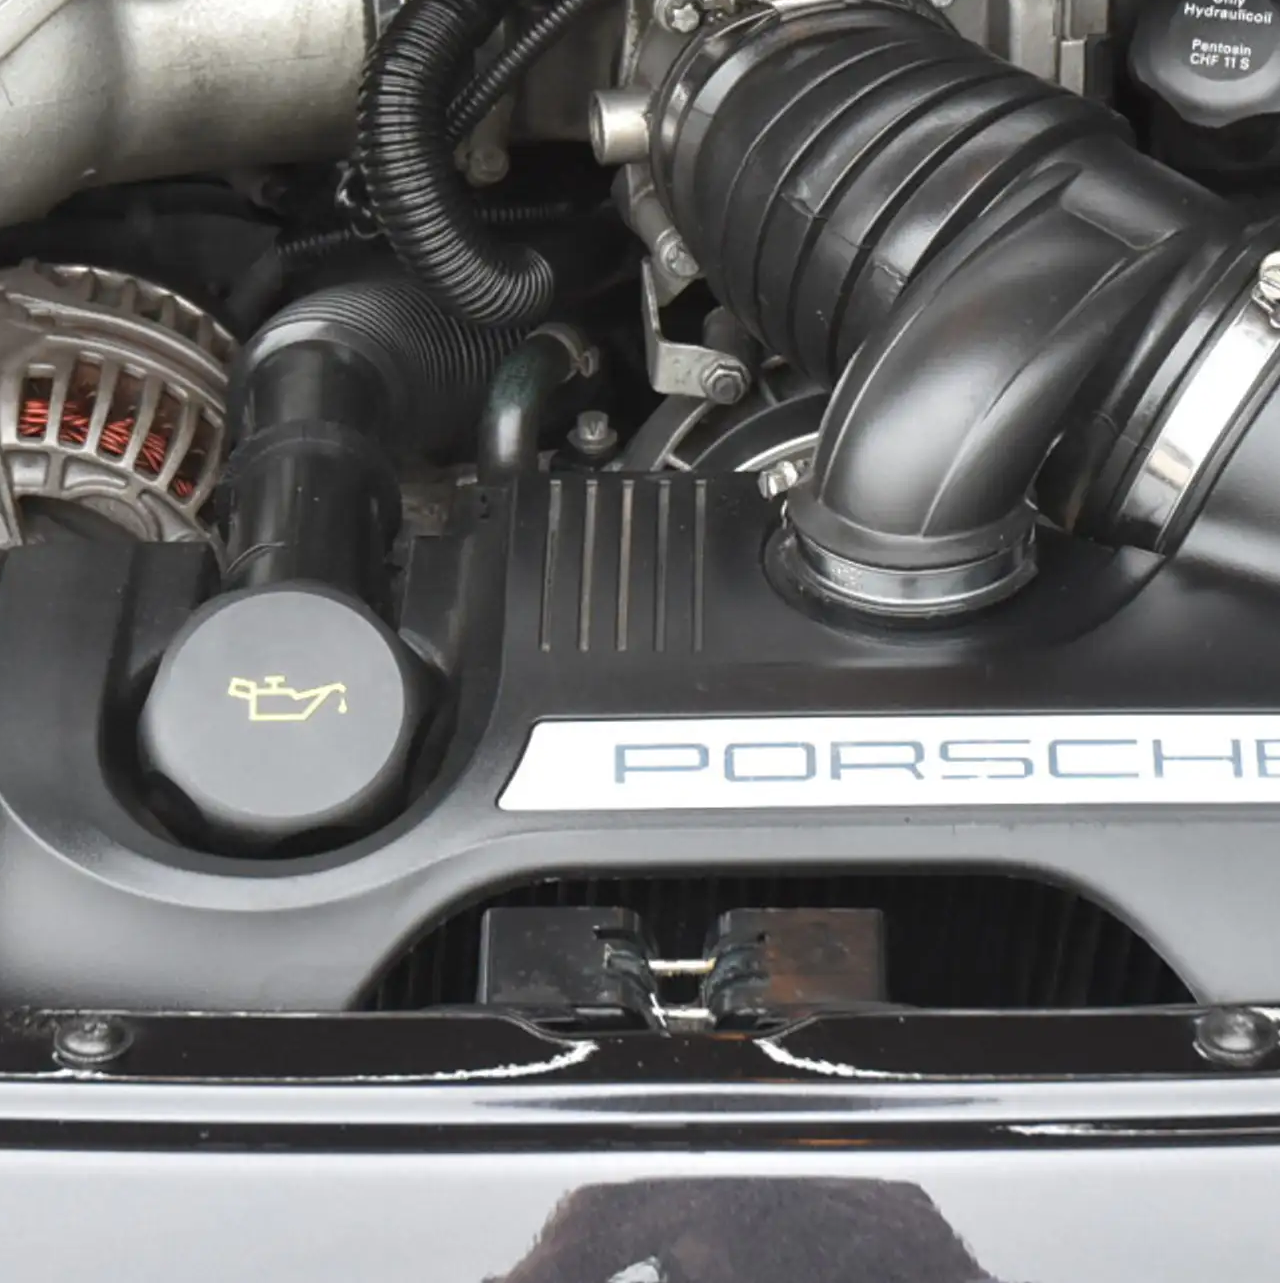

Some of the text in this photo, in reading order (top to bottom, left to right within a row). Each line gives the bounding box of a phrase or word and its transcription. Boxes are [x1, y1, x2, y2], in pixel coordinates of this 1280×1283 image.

[1183, 1, 1273, 25] Hydraulicoil
[1191, 37, 1252, 56] Pentosin
[1190, 52, 1250, 72] CHF 11 S
